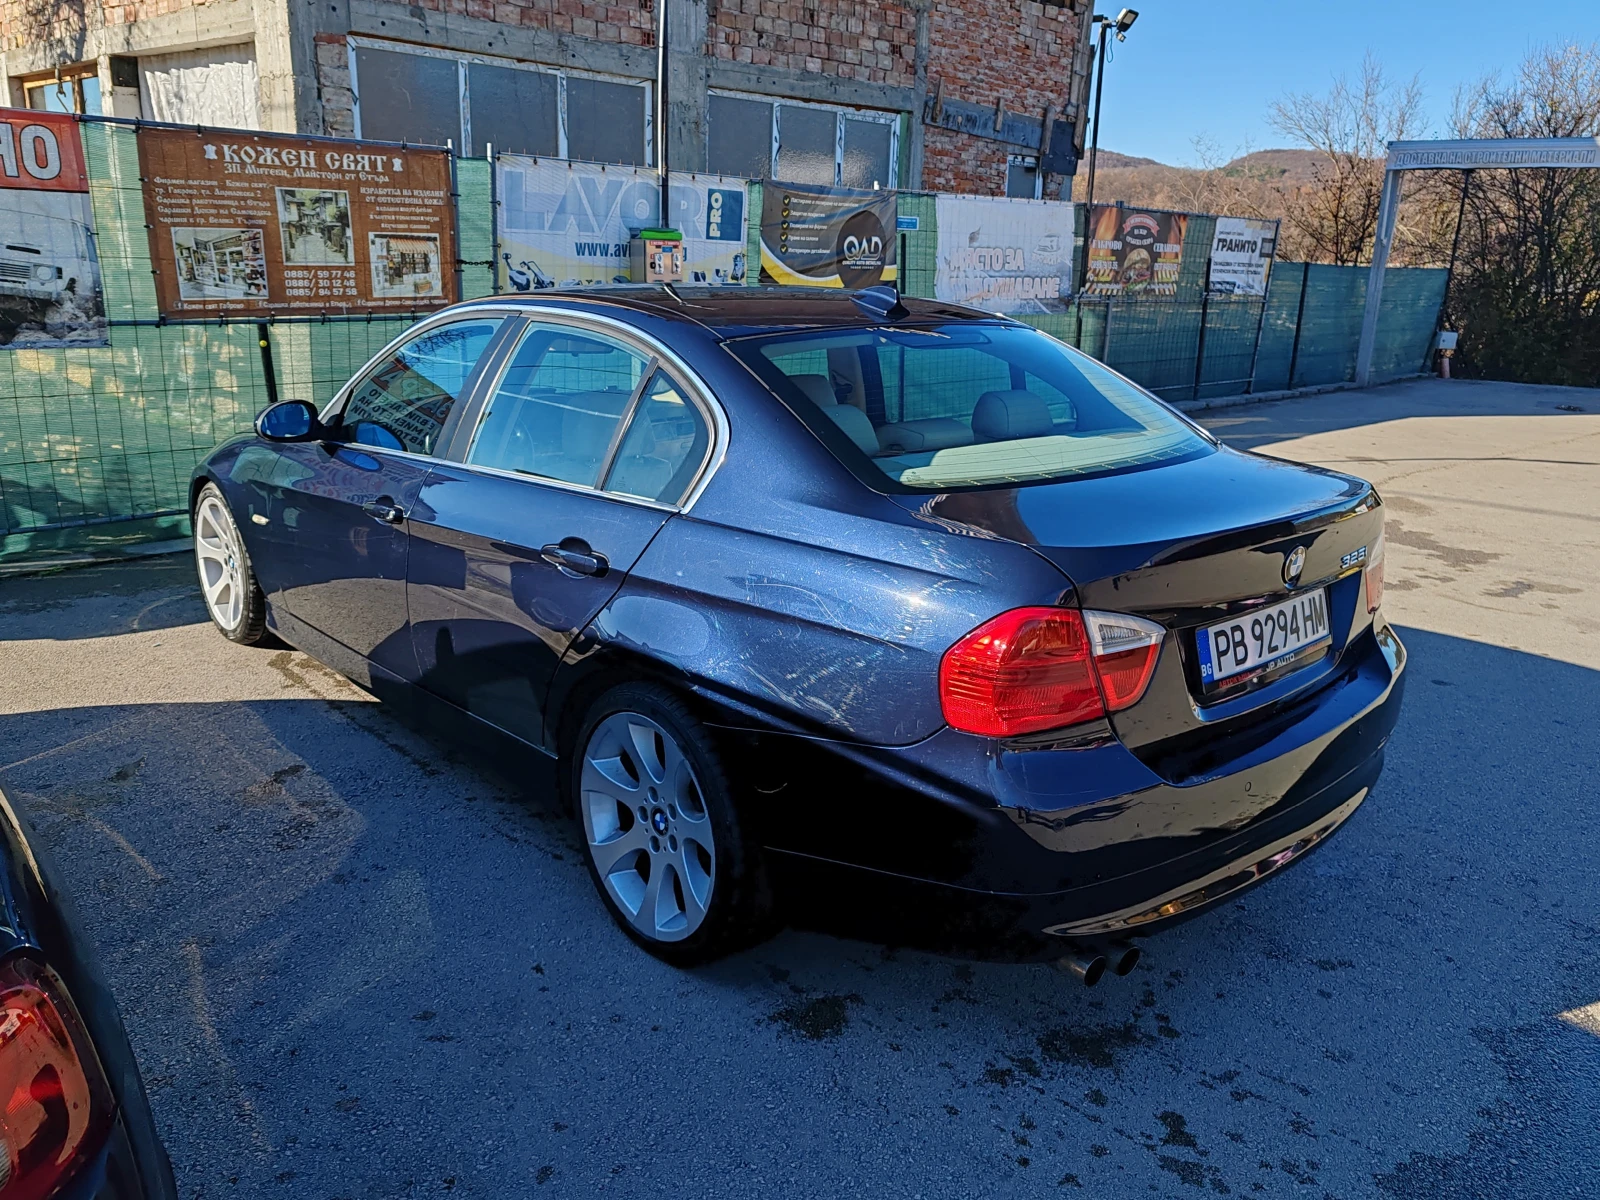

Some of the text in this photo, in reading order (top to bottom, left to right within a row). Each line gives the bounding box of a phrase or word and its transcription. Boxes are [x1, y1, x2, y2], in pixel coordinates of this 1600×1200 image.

[221, 144, 387, 172] КОЖЕН СВЯТ
[1396, 150, 1596, 167] ДОСТАВКА НА СТРОИТЕЛНИ МАТЕРИАЛИ
[293, 168, 342, 182] Майстори
[344, 172, 356, 180] от
[503, 168, 706, 239] LAVOR
[710, 192, 722, 238] PRO
[843, 236, 883, 260] QAD
[1216, 238, 1257, 254] ГРАНИТО
[950, 247, 1004, 271] МЯСТО
[1004, 248, 1024, 271] ЗА
[284, 270, 314, 279] 0885/
[285, 279, 315, 288] 0886/
[286, 288, 316, 297] 0885/
[1214, 594, 1326, 672] PB 9294 HM
[1201, 663, 1212, 676] BG
[1266, 653, 1295, 672] JP AUTO
